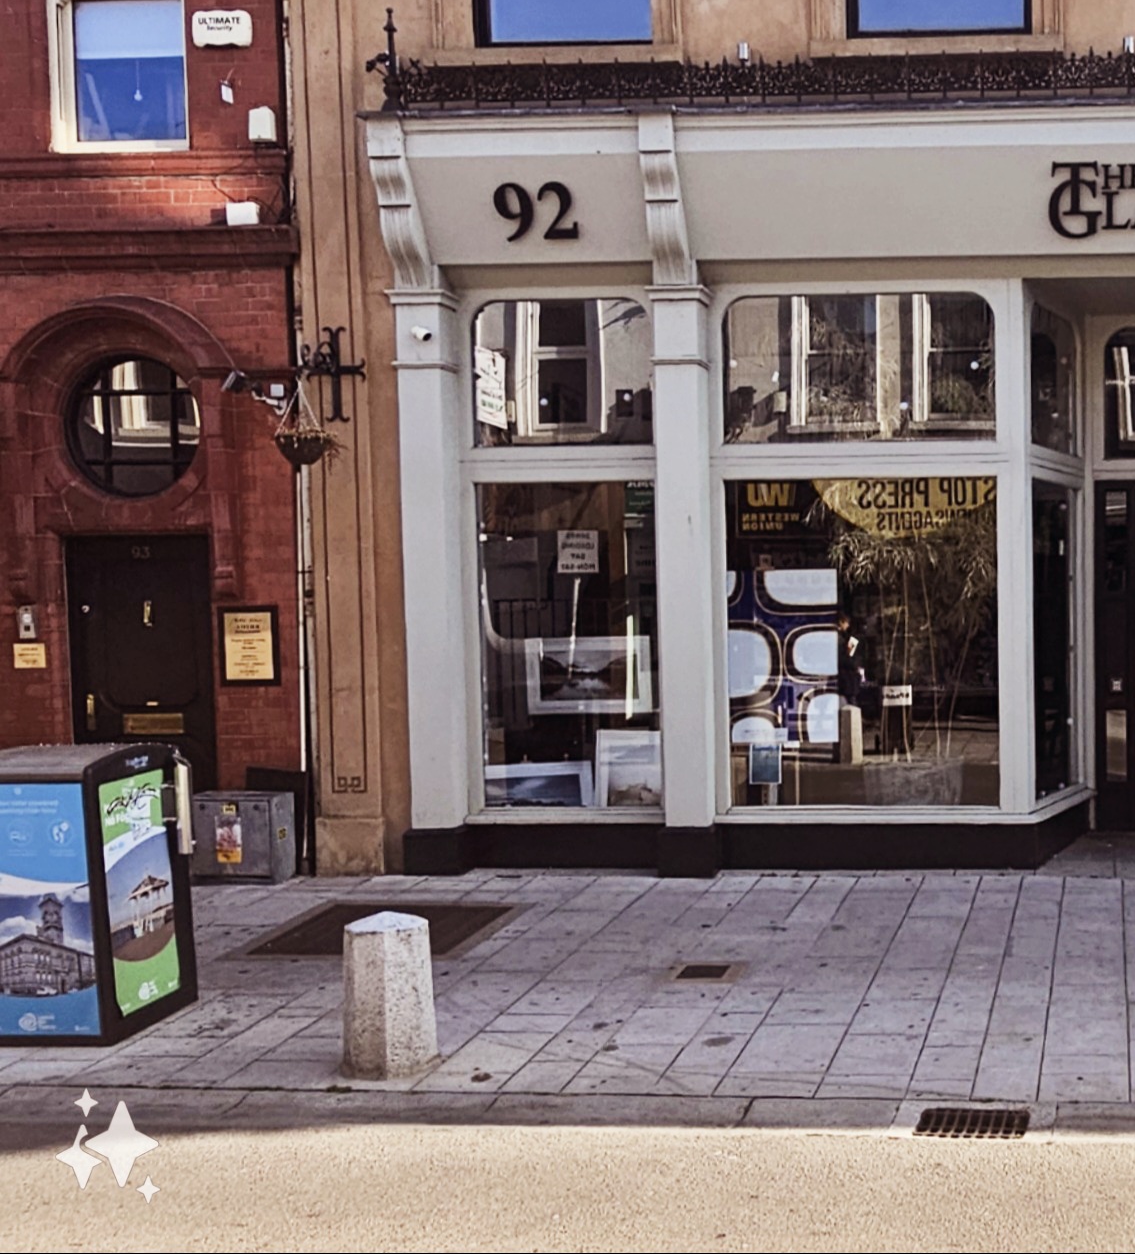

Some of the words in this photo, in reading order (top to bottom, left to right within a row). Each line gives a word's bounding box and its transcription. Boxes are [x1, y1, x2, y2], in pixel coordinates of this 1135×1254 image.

[197, 16, 241, 25] ULTIMATE
[493, 181, 579, 242] 92
[131, 546, 150, 559] 93
